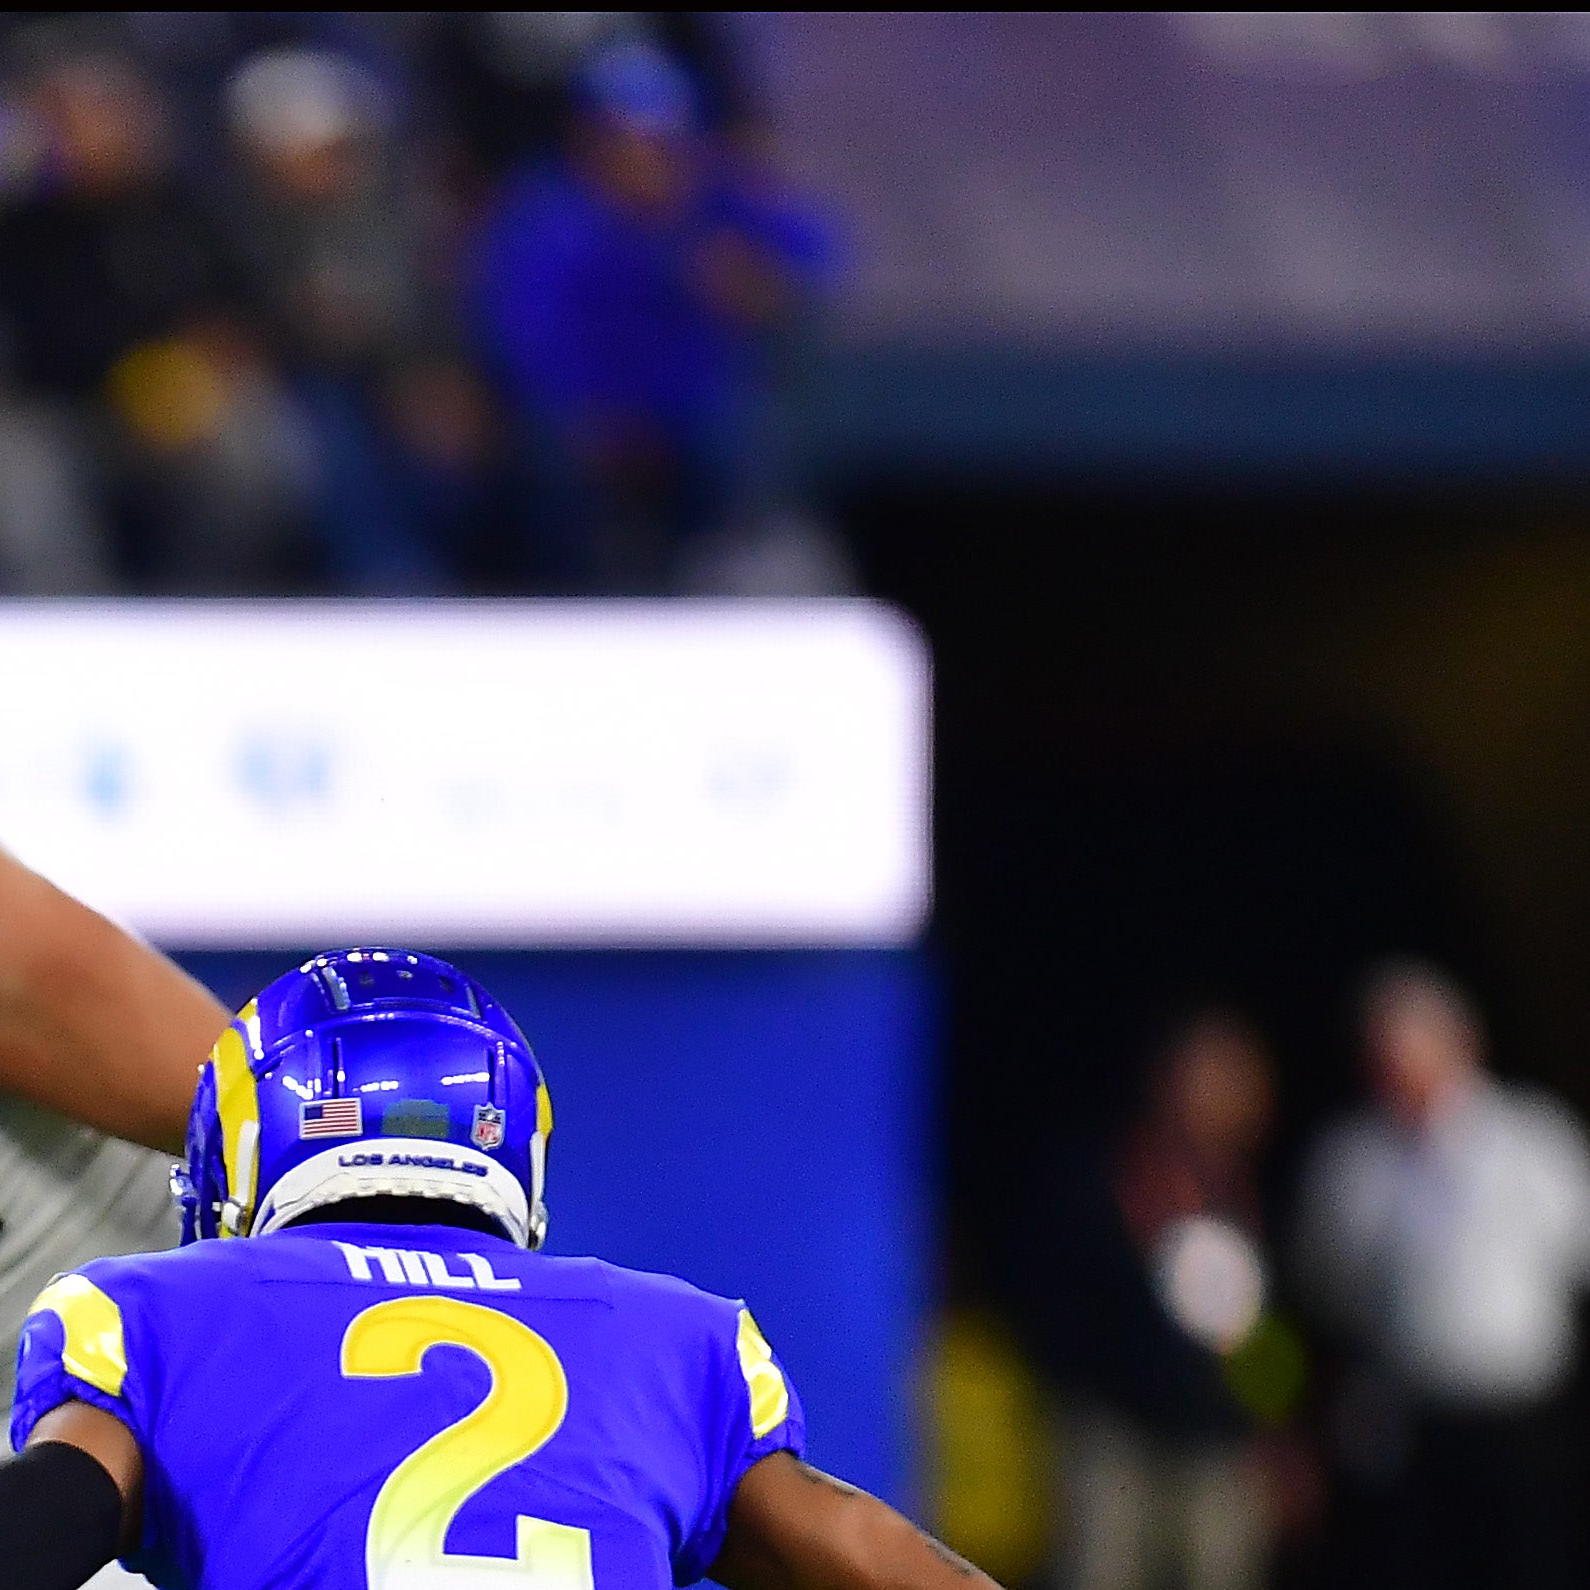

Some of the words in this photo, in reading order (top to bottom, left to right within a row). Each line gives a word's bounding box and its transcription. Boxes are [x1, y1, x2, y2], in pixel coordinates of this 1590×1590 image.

[338, 1153, 383, 1167] LOS
[388, 1153, 489, 1178] ANGELES
[331, 1240, 521, 1289] HILL
